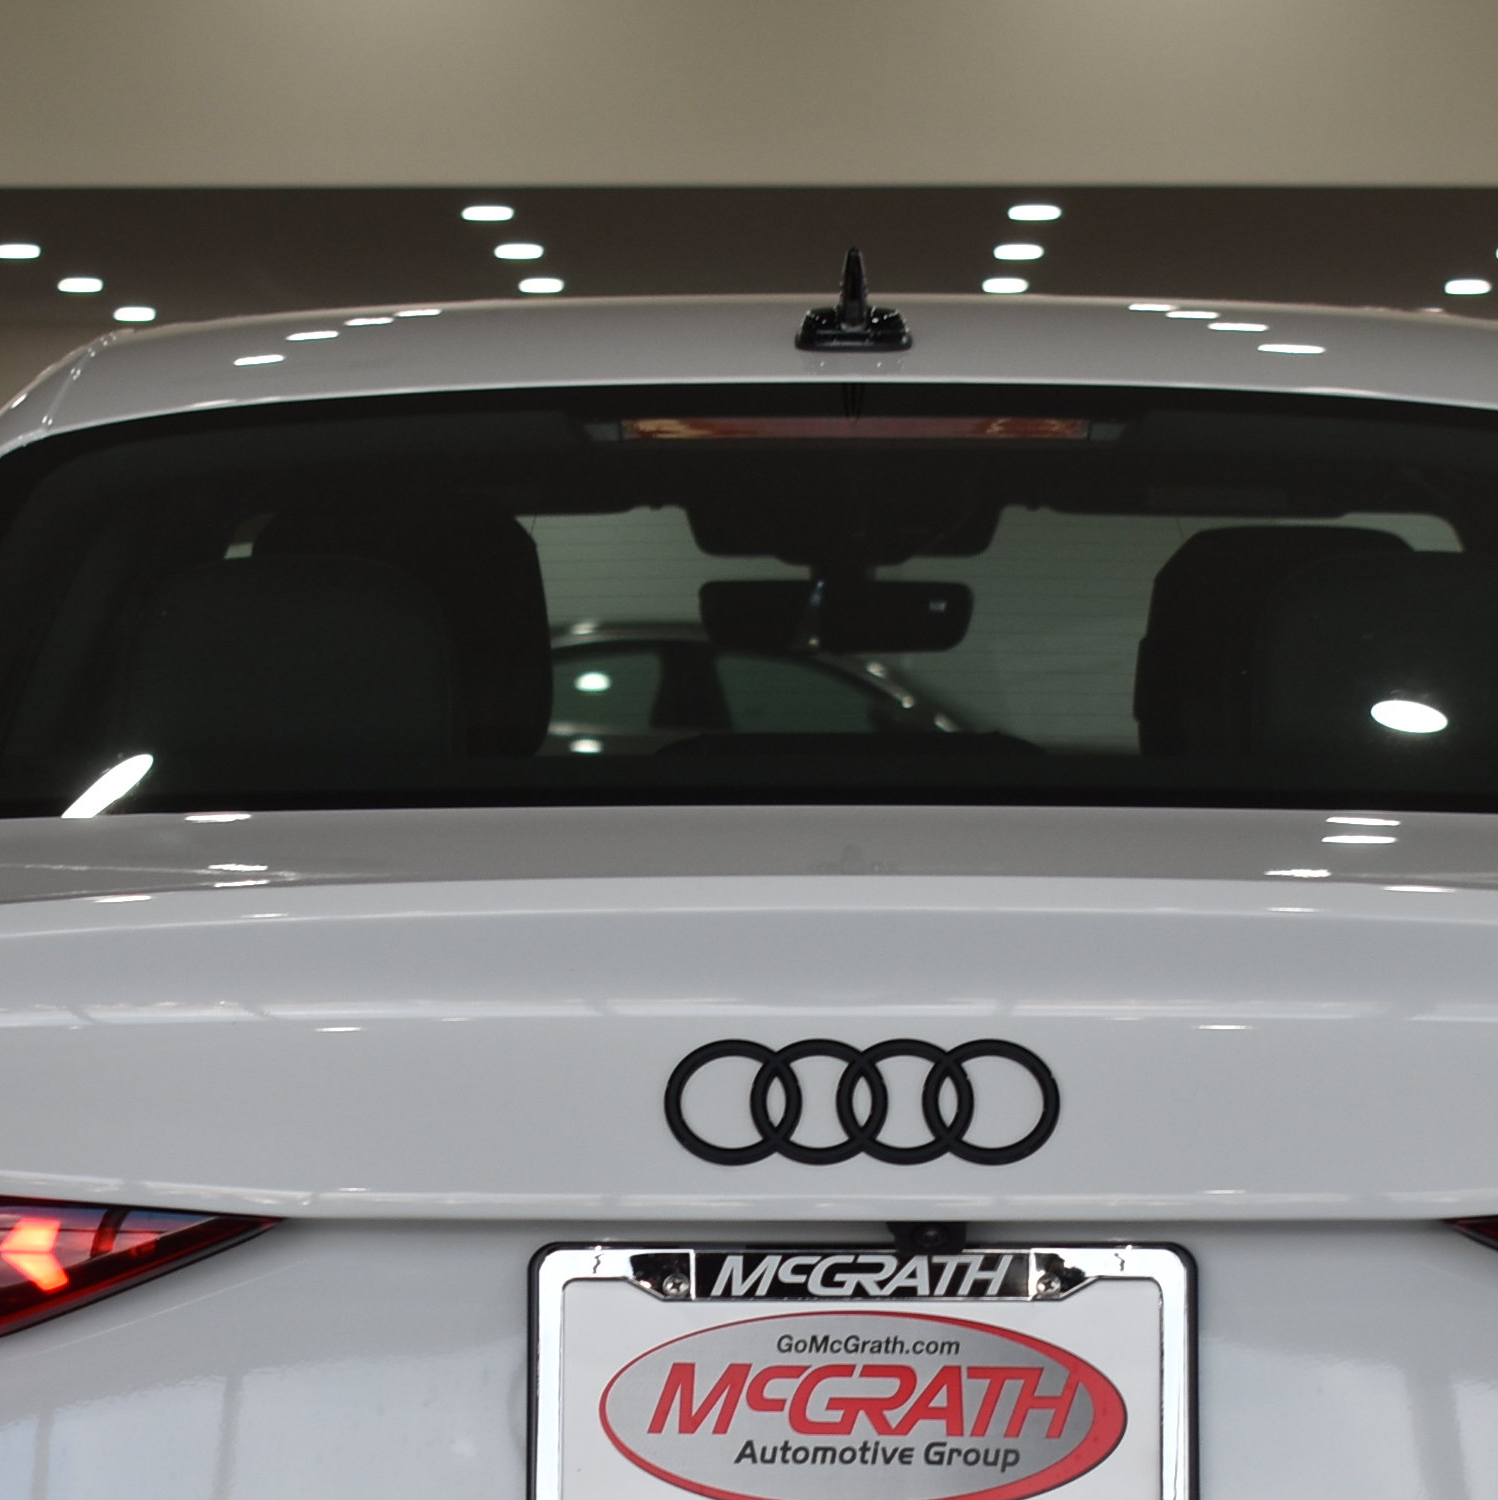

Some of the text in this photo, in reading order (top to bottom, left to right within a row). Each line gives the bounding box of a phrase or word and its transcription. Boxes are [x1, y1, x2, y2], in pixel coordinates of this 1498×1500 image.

[775, 1332, 961, 1357] GoMcGrath.com
[733, 1440, 1021, 1473] Automotive Group
